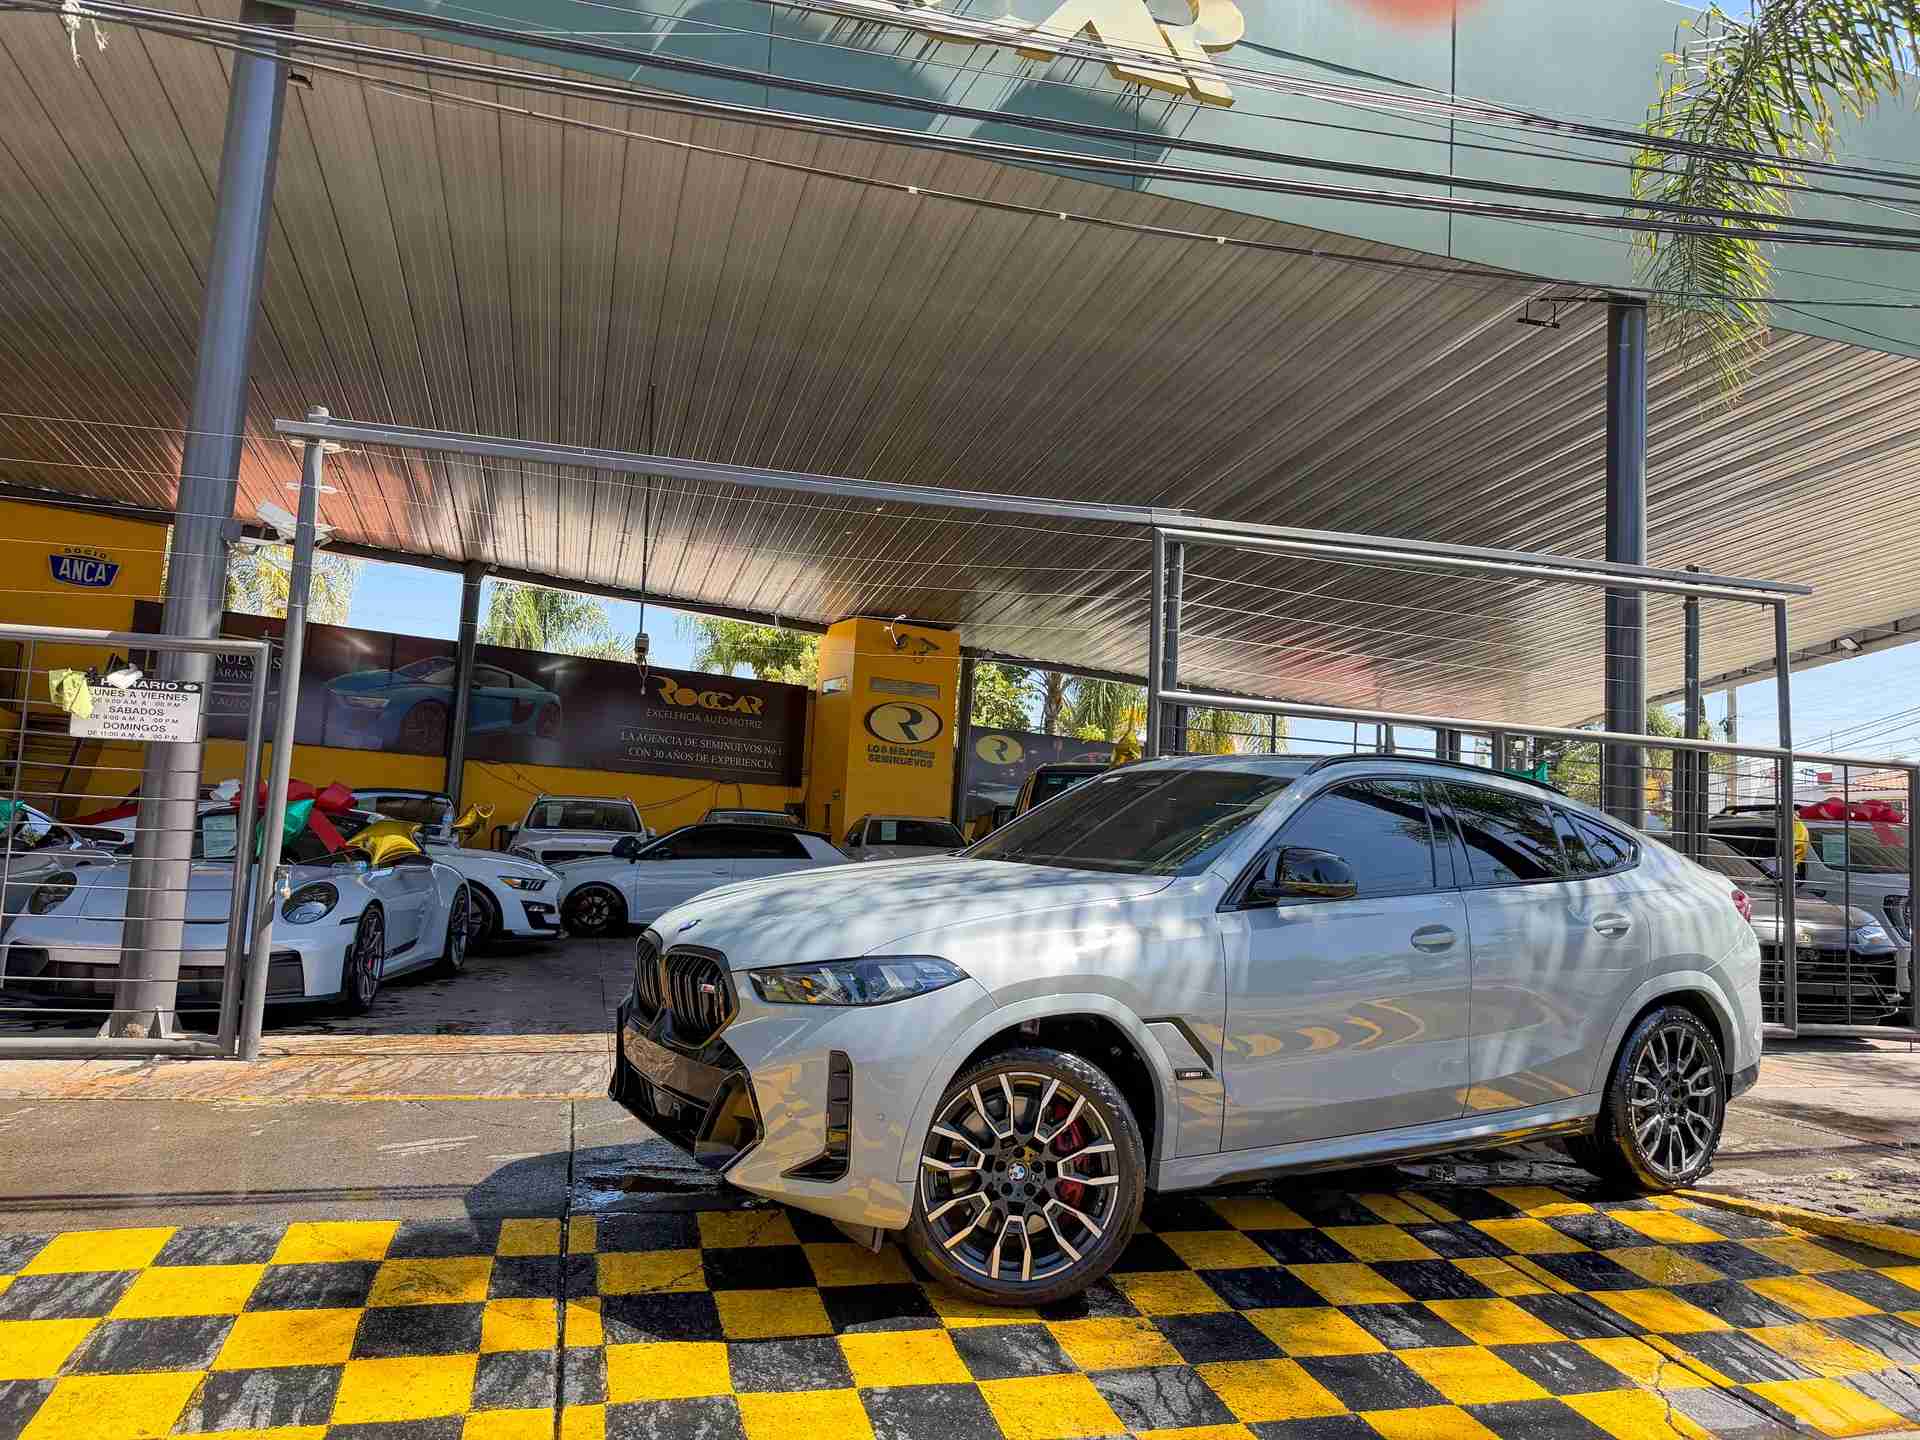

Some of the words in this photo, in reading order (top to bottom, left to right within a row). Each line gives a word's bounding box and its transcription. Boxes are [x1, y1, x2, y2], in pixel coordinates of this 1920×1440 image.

[58, 558, 107, 583] ANCA
[100, 678, 178, 690] HARIO
[129, 690, 137, 698] A
[141, 691, 188, 702] VIERNES
[646, 673, 764, 714] ROCCAR
[103, 721, 167, 733] DOMINGOS
[637, 733, 682, 747] AGENCIA
[699, 739, 762, 754] SEMINUEVOS
[711, 755, 774, 769] EXPERIENCIA
